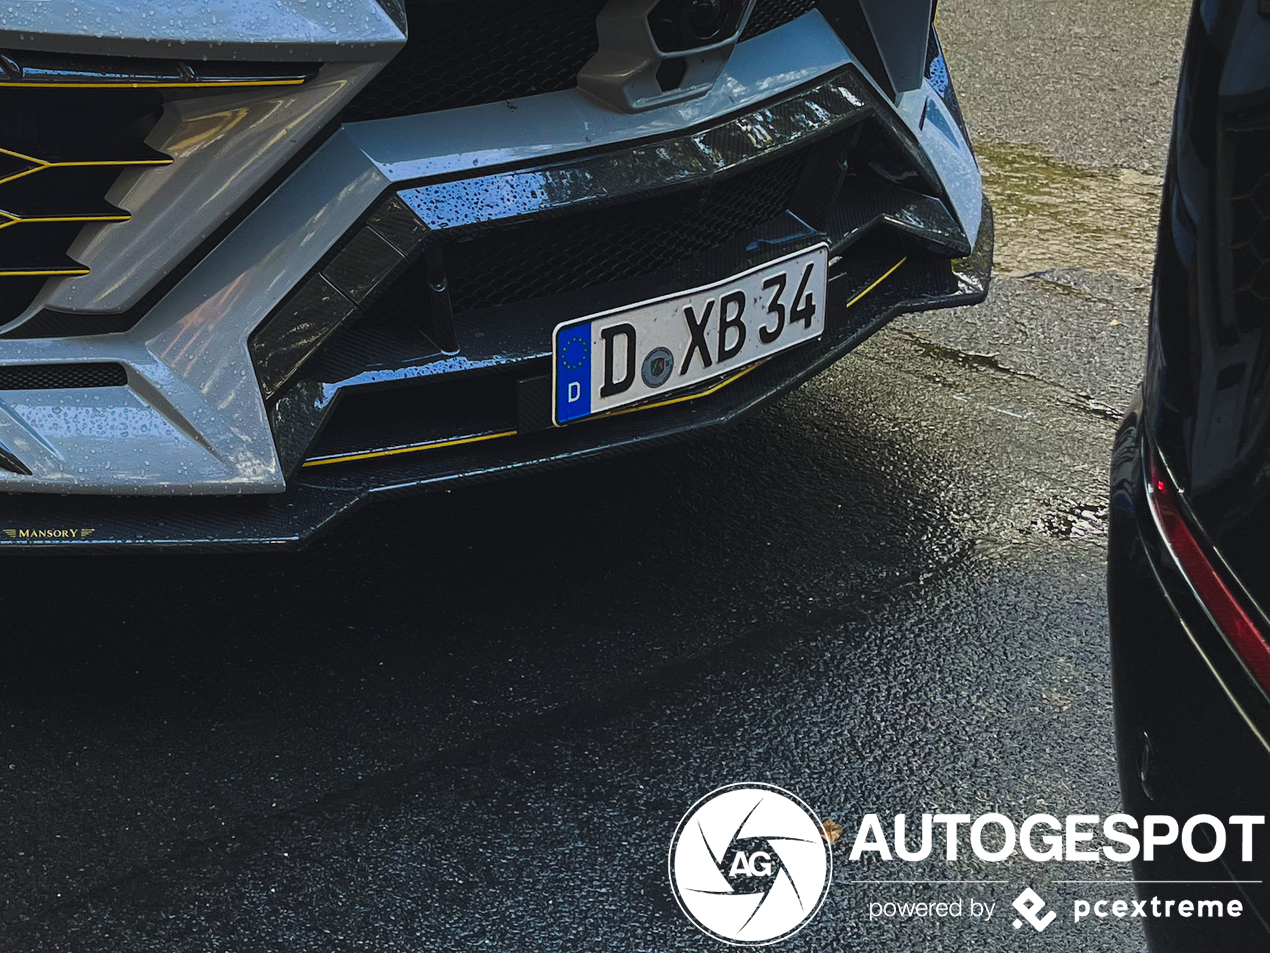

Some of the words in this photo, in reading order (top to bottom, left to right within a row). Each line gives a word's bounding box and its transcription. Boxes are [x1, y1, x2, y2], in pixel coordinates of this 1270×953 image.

[599, 323, 637, 399] D
[679, 290, 747, 376] XB
[758, 260, 816, 345] 34
[568, 381, 581, 403] D
[18, 529, 78, 538] MANSORY
